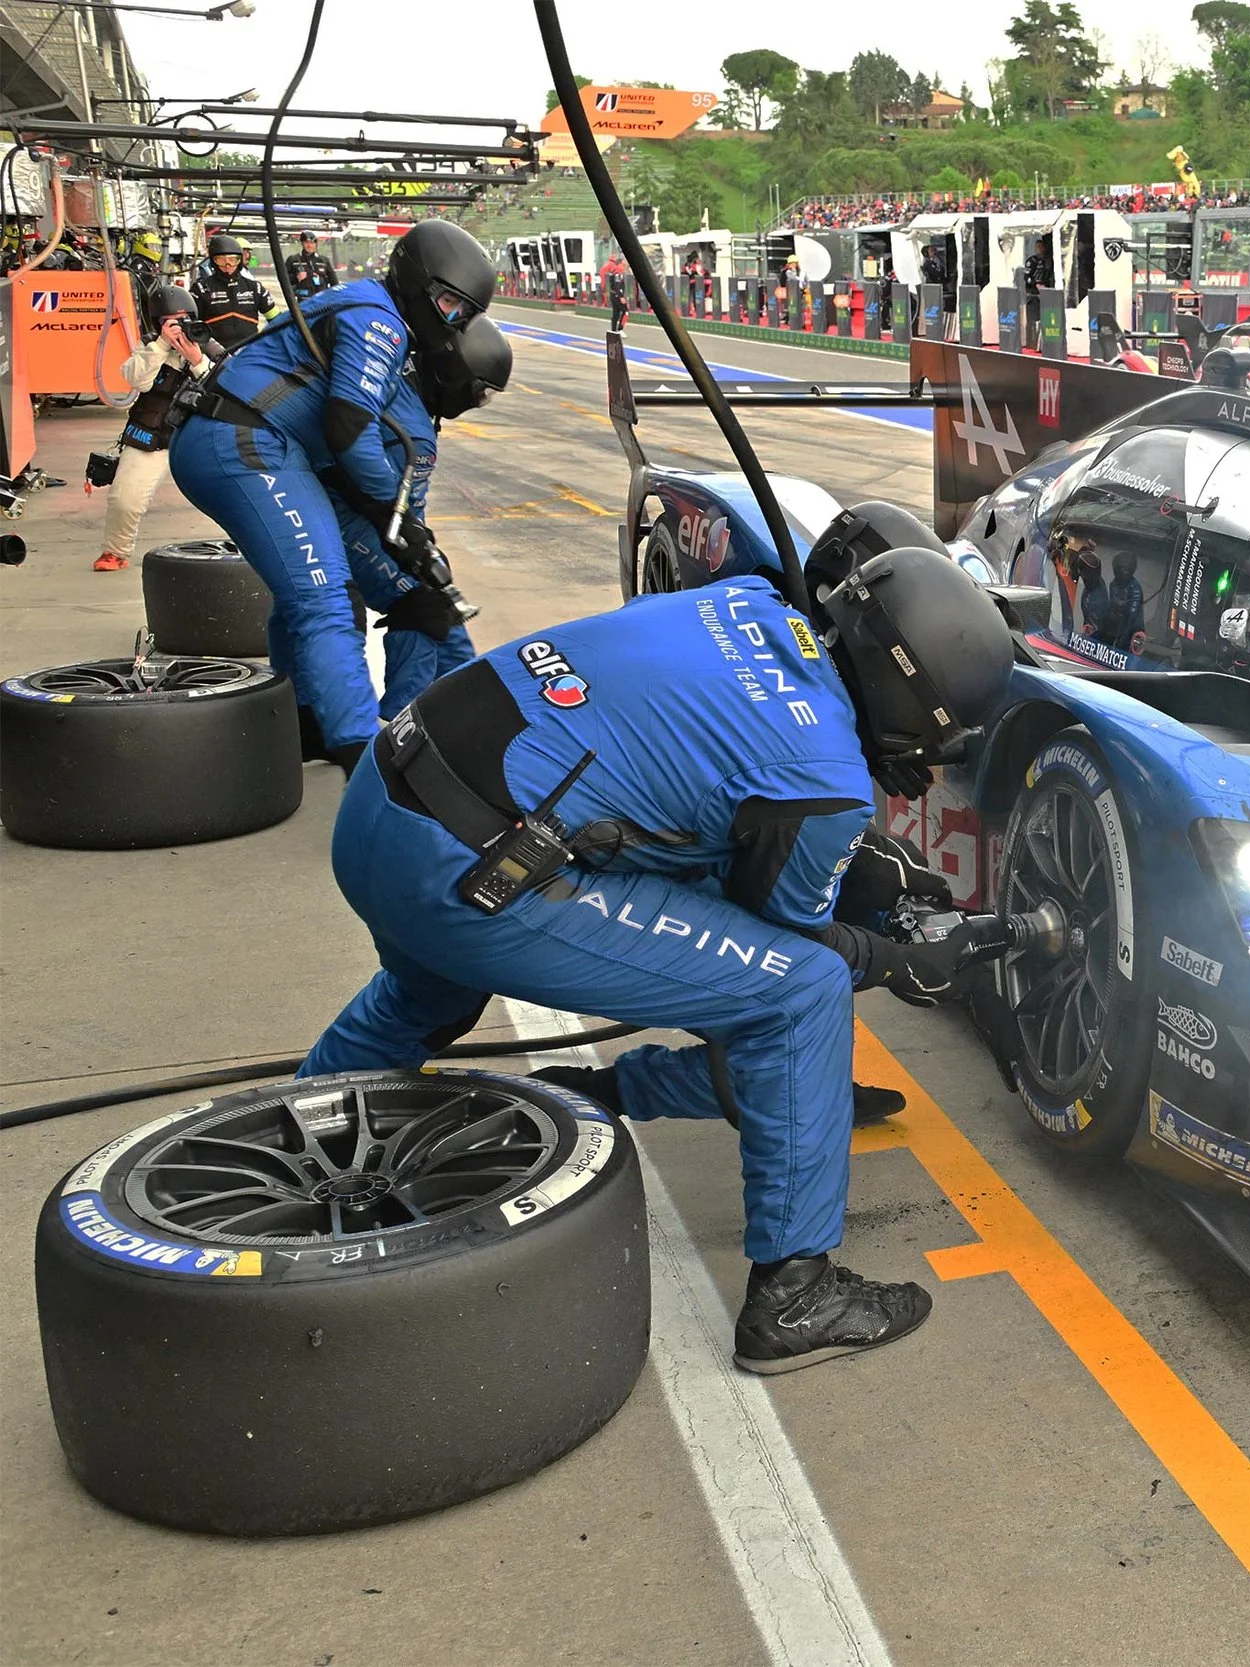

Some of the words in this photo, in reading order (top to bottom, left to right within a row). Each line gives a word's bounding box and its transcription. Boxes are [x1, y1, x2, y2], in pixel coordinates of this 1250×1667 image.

[692, 93, 712, 107] 95
[593, 121, 656, 131] McLaren
[1039, 378, 1060, 417] HY
[132, 429, 153, 445] LANE
[1102, 459, 1171, 498] businessolver
[259, 473, 328, 587] ALPINE
[678, 514, 711, 561] elf
[341, 532, 413, 592] PINE
[1173, 528, 1196, 607] M.SCHUMACHER
[1191, 561, 1205, 615] J.GOUNON
[521, 640, 572, 676] elf
[696, 599, 743, 661] ENDURANCE
[734, 667, 768, 702] TEAM
[725, 586, 819, 727] ALPINE
[790, 621, 817, 656] Sabelt
[1068, 632, 1128, 671] MOSER.WATCH
[894, 647, 914, 676] MSA
[935, 709, 950, 725] MSA
[1043, 746, 1100, 788] MICHELIN
[1101, 802, 1116, 838] PILOT
[1111, 841, 1125, 892] SPORT
[577, 890, 793, 977] ALPINE
[1118, 942, 1130, 965] S
[1166, 941, 1217, 985] Sabelt
[1157, 1029, 1216, 1080] BAHCO
[591, 1125, 604, 1149] PILOT
[76, 1162, 100, 1186] PILOT
[97, 1133, 135, 1160] SPORT
[573, 1146, 595, 1178] SPORT
[514, 1196, 537, 1215] S
[67, 1198, 194, 1265] MICHELIN
[332, 1246, 363, 1264] FR
